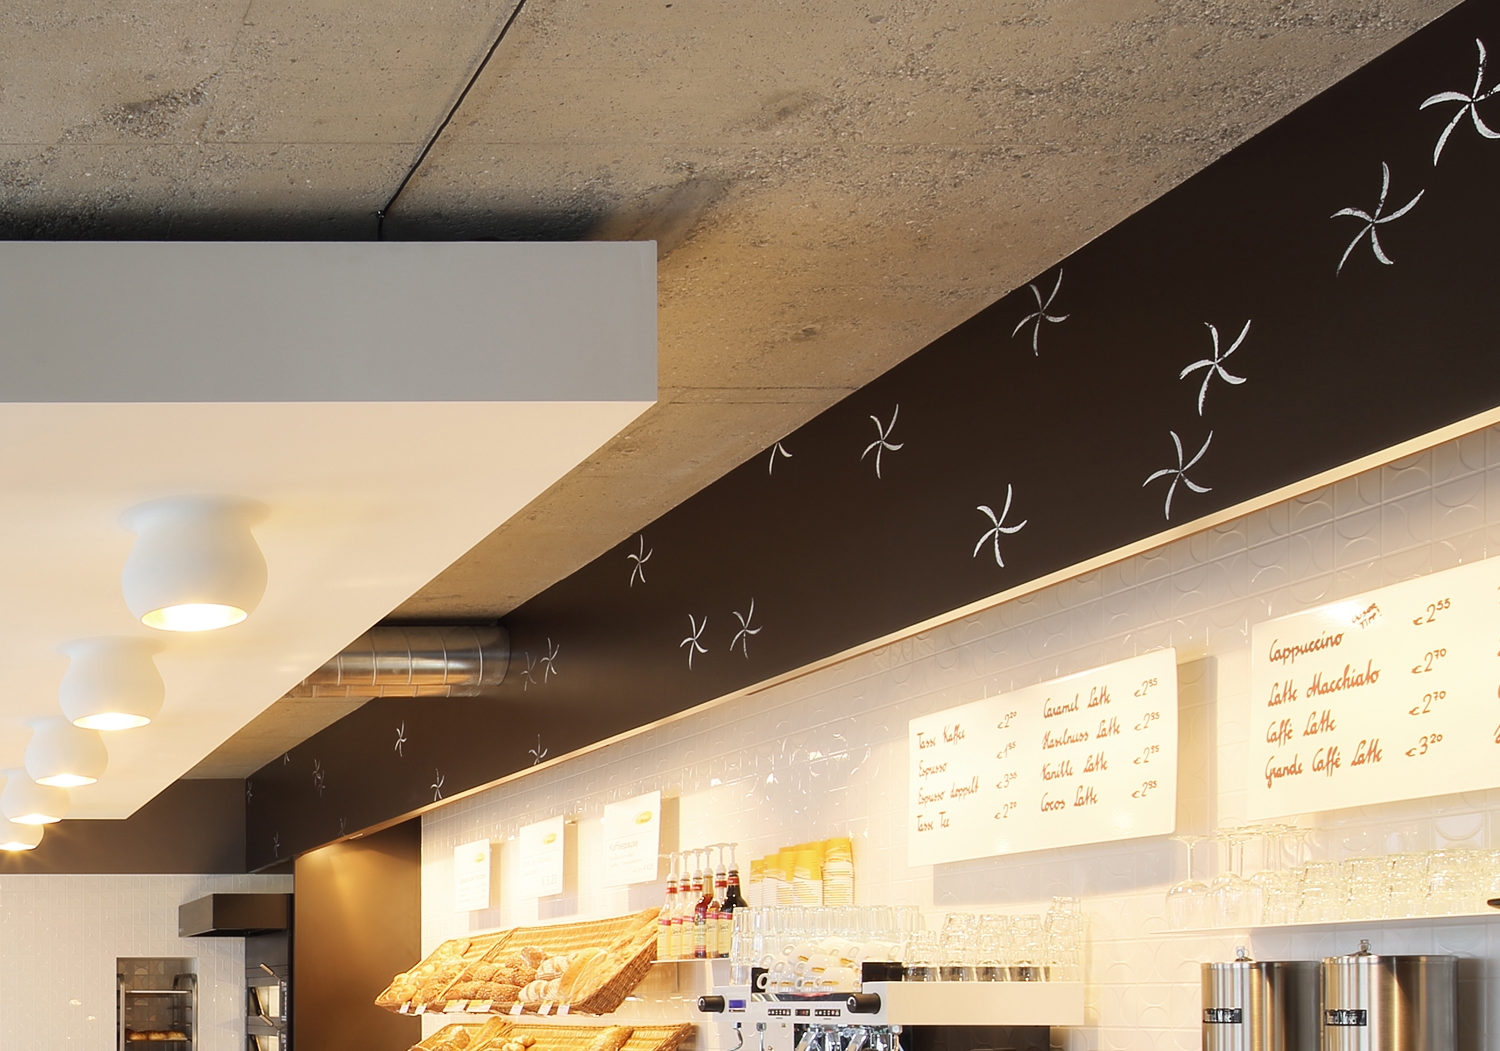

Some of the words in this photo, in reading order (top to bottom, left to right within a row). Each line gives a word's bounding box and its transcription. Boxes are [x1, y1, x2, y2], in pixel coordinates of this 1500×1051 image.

[1269, 630, 1345, 665] Cappuccino
[1267, 679, 1298, 707] Latte
[1306, 659, 1381, 698] Macchiato
[1043, 693, 1079, 719] Caramel
[1087, 685, 1111, 708] Latte
[917, 732, 936, 749] Tasse
[942, 724, 965, 747] Kaffee
[1042, 728, 1089, 750] Haselnuss
[1096, 716, 1120, 739] Latte
[1303, 709, 1337, 737] Latte
[919, 760, 947, 779] Espresso
[1040, 760, 1074, 781] Vanille
[1083, 751, 1108, 773] Latte
[1265, 753, 1304, 789] Grande
[1350, 738, 1383, 767] Latte
[918, 787, 945, 807] Espresso
[950, 776, 979, 800] doppelt
[1041, 792, 1066, 812] Cocos
[1073, 785, 1098, 807] Latte
[917, 814, 933, 832] Tasse
[939, 811, 950, 828] Tee
